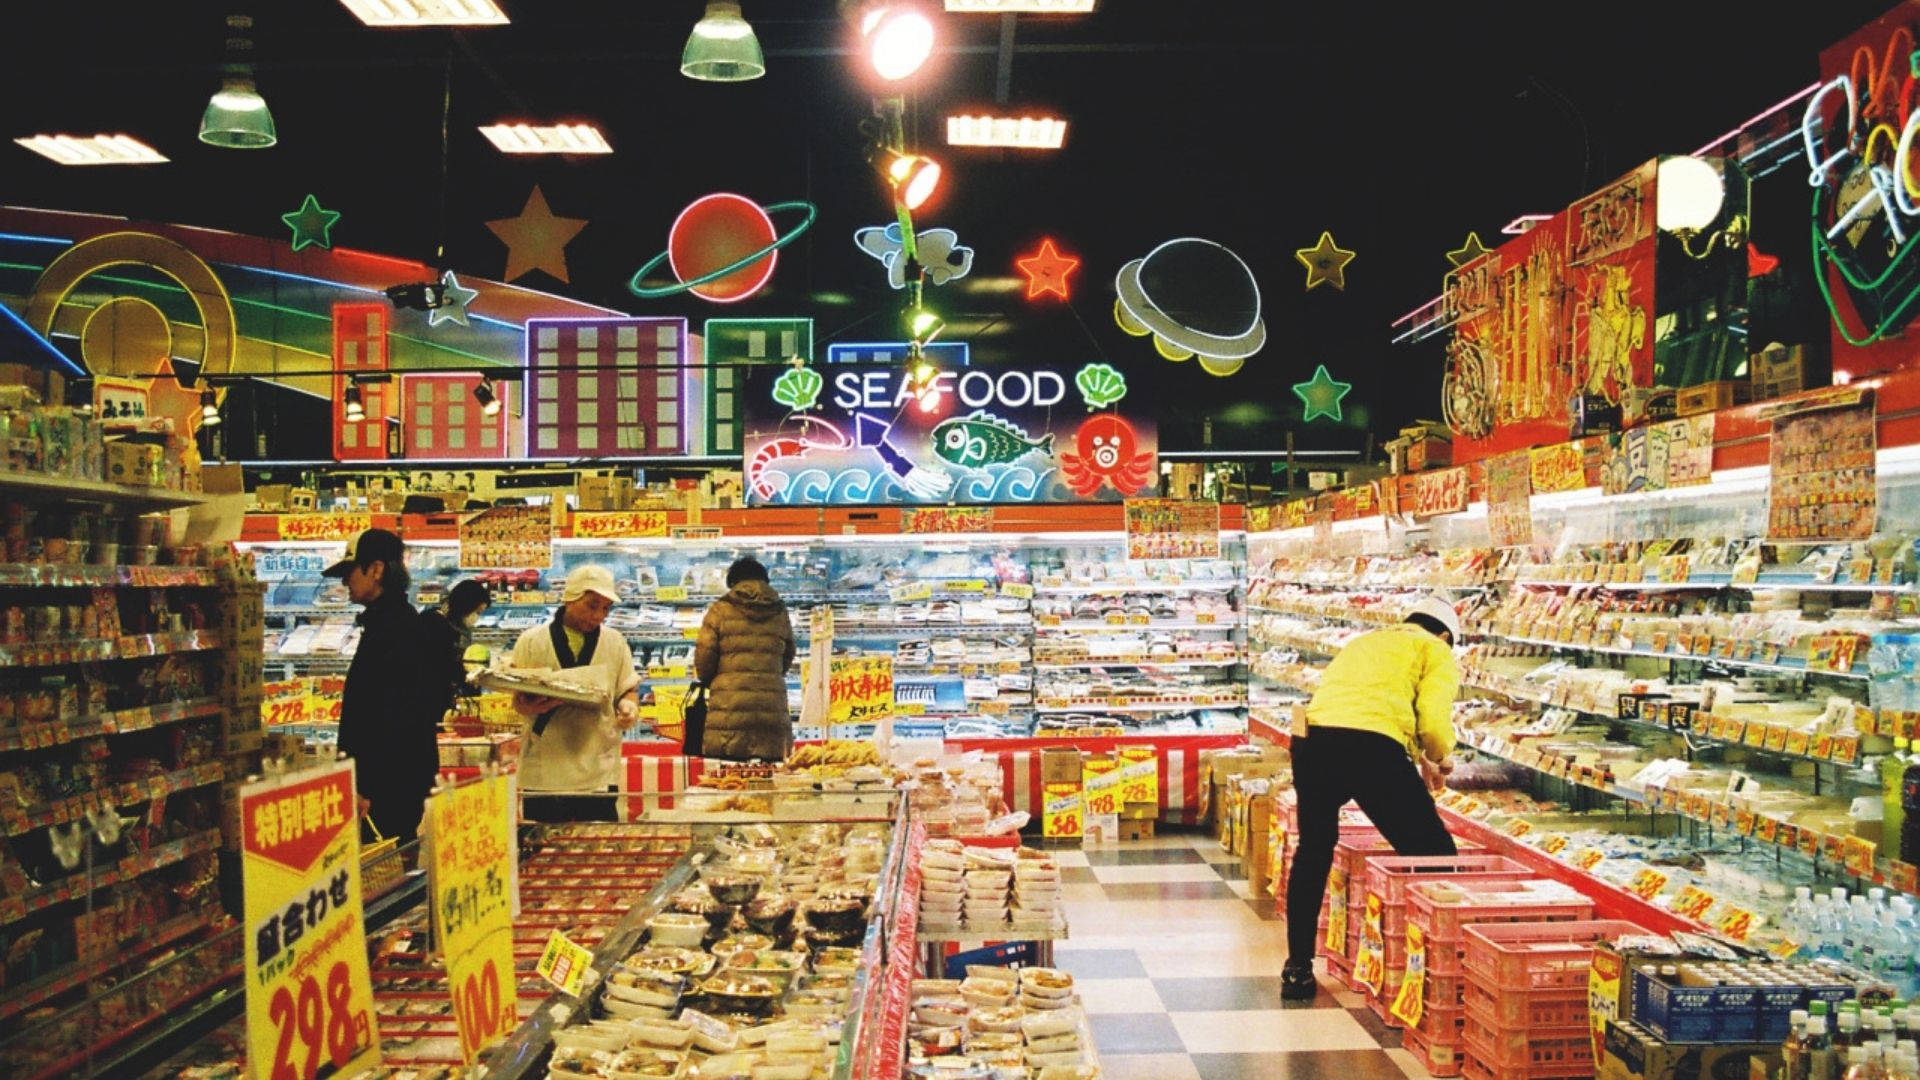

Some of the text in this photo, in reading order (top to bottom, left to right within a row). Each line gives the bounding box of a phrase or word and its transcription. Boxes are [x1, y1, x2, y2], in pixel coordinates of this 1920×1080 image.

[834, 371, 1066, 408] SEAFOOD
[254, 784, 344, 849] 特別奉仕
